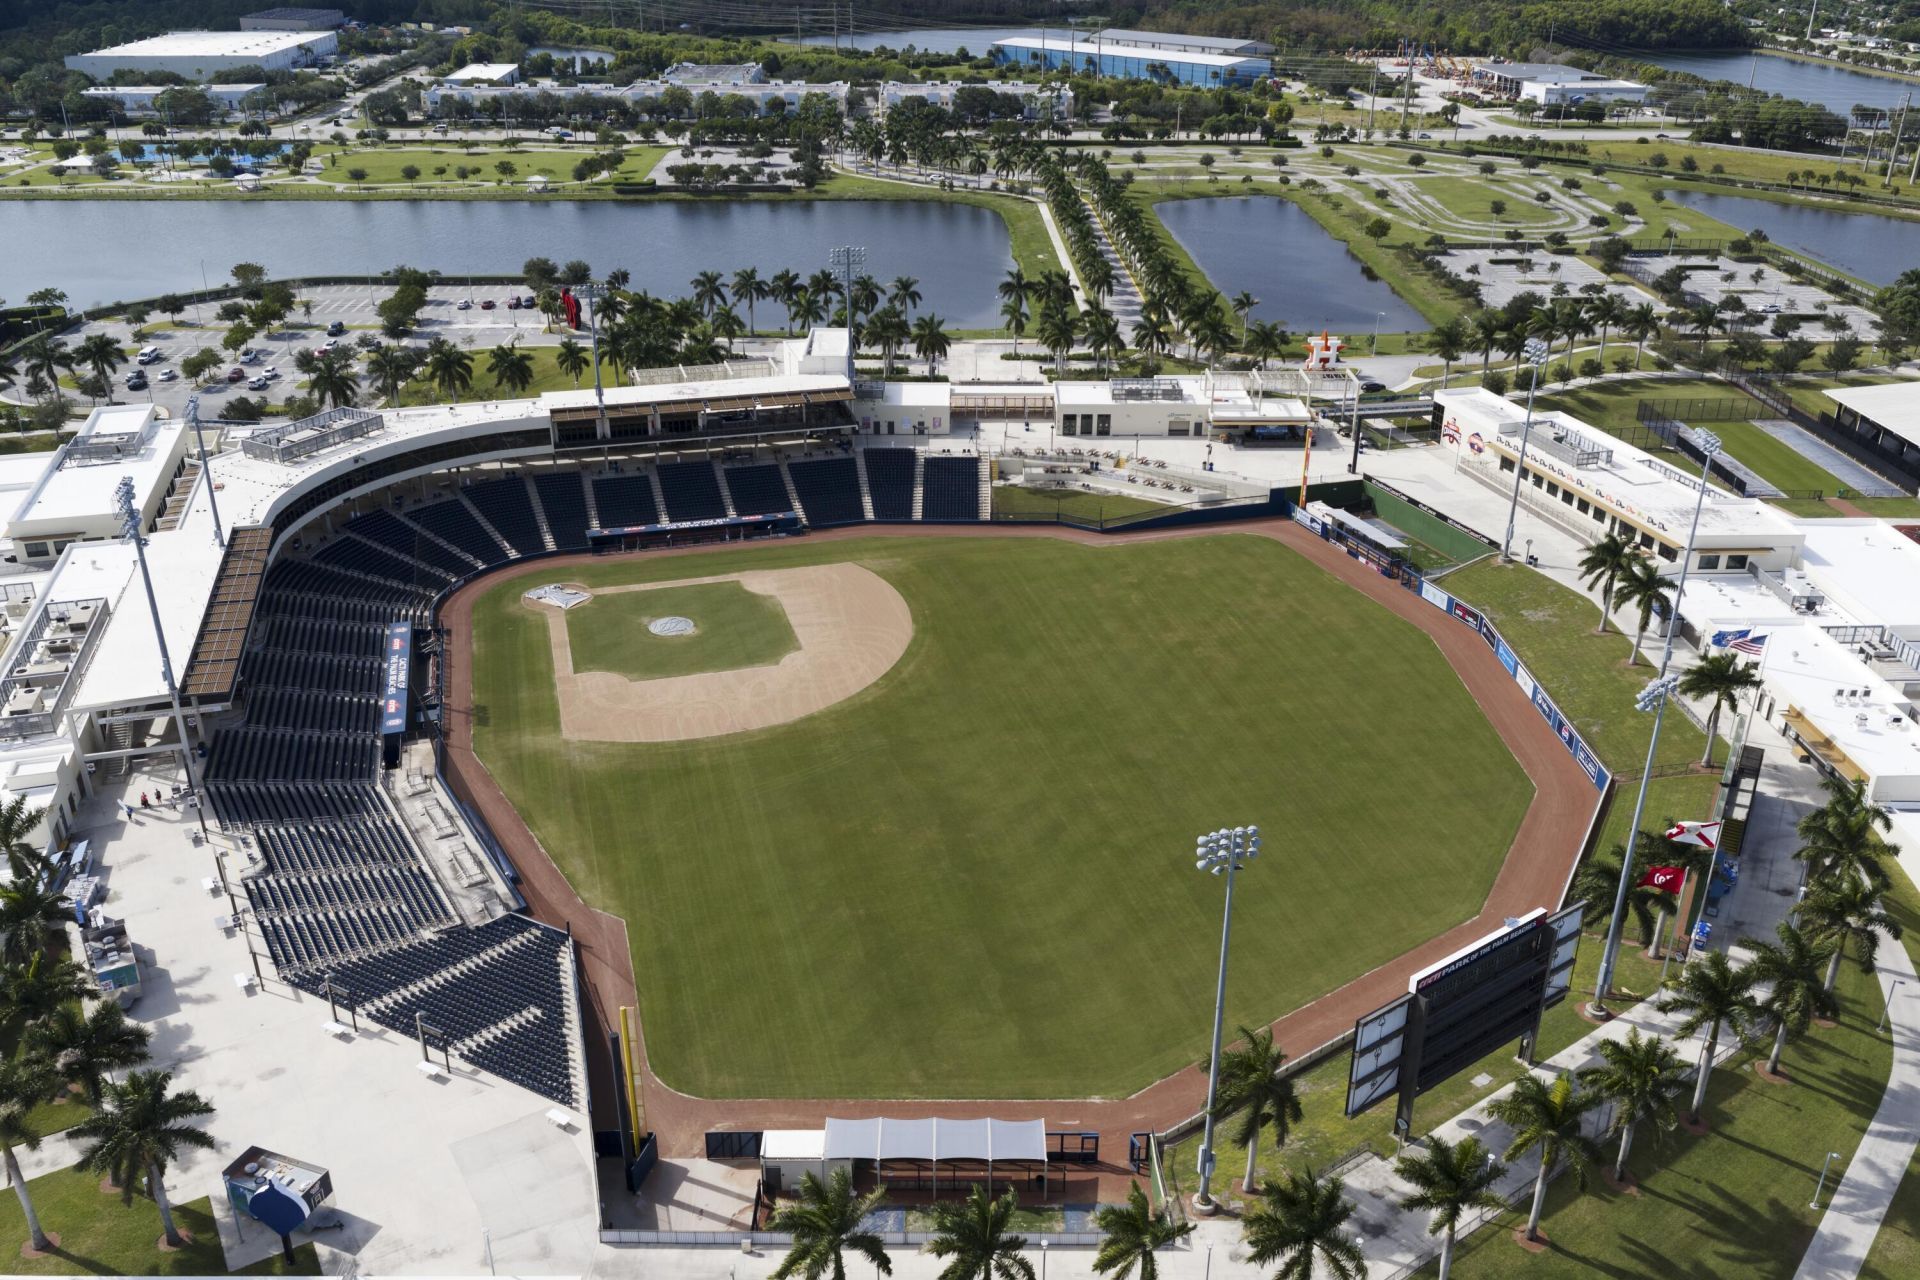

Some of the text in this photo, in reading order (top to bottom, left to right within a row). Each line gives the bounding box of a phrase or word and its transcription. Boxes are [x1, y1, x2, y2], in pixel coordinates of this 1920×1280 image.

[388, 654, 398, 694] THE PALM BEACHES
[398, 670, 406, 682] PARK
[399, 658, 407, 670] CACTI
[1418, 971, 1440, 989] CACTI
[1442, 957, 1469, 976] PARK
[1480, 946, 1491, 956] THE
[1492, 936, 1509, 949] PALM
[1510, 921, 1536, 940] BEACHES
